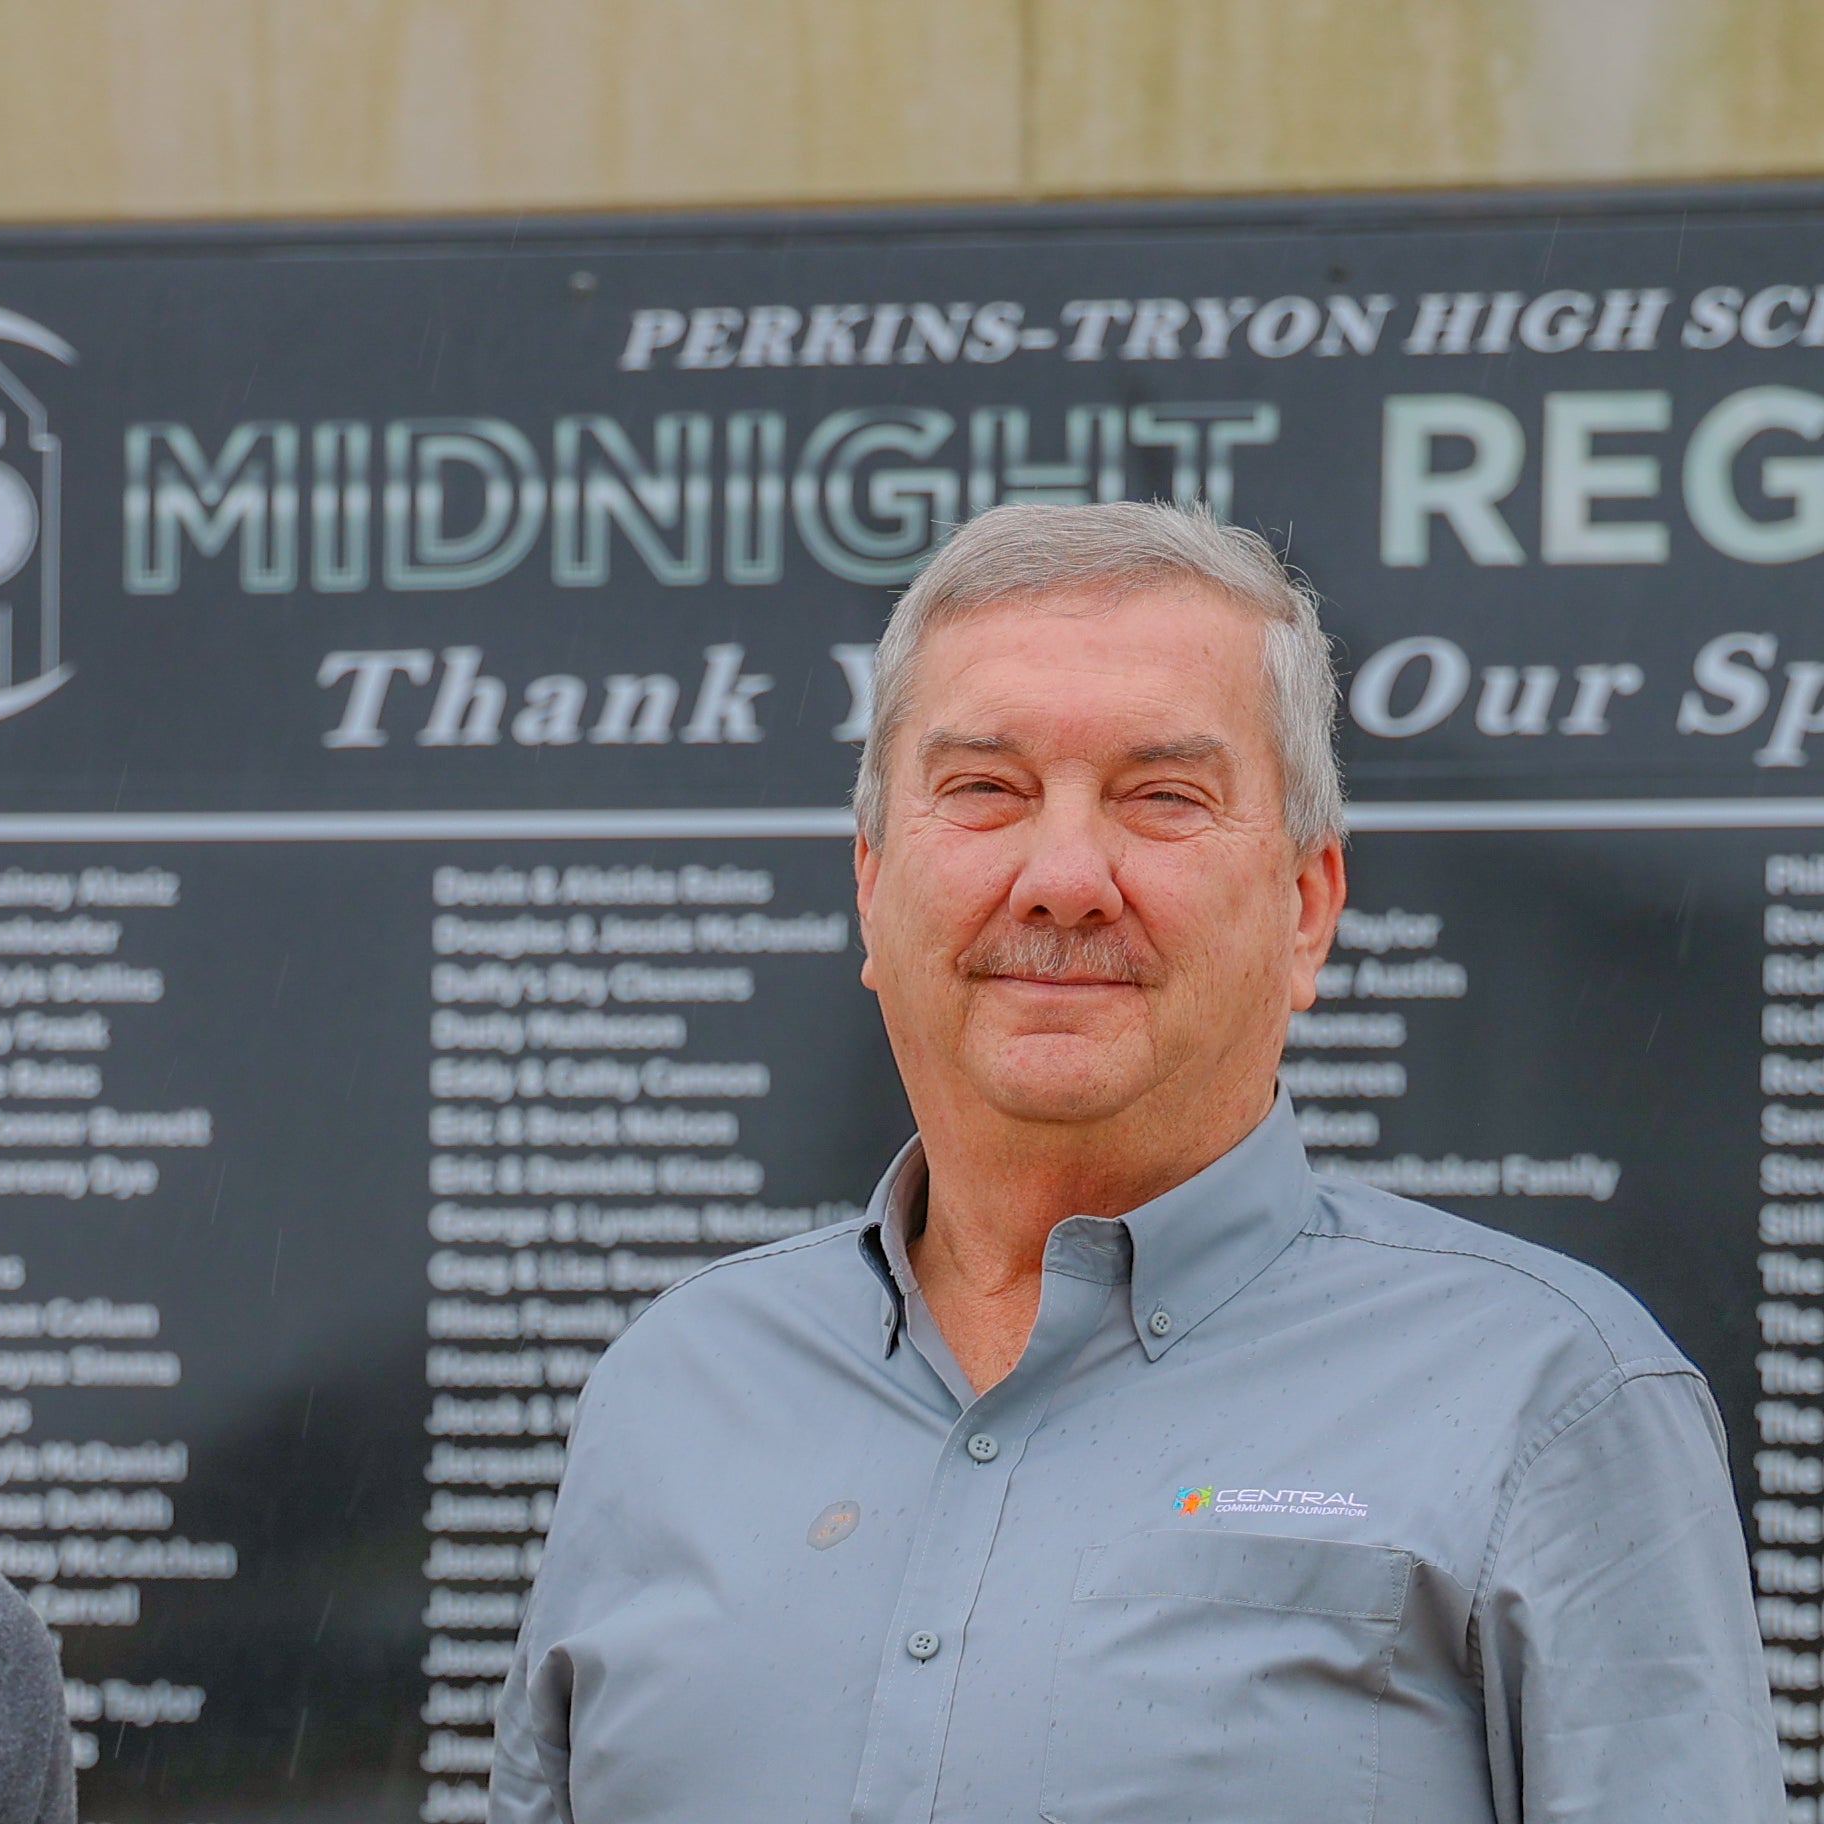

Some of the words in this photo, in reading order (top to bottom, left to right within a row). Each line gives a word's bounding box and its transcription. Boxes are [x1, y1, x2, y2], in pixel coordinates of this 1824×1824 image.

[622, 294, 1392, 371] PERKINS-TRYON
[1406, 288, 1670, 355] HIGH
[317, 643, 768, 748] Thank
[1350, 636, 1643, 737] Our
[1214, 1487, 1369, 1508] CENTRAL
[1214, 1502, 1289, 1513] COMMUNITY
[1288, 1505, 1368, 1517] FOUNDATION
